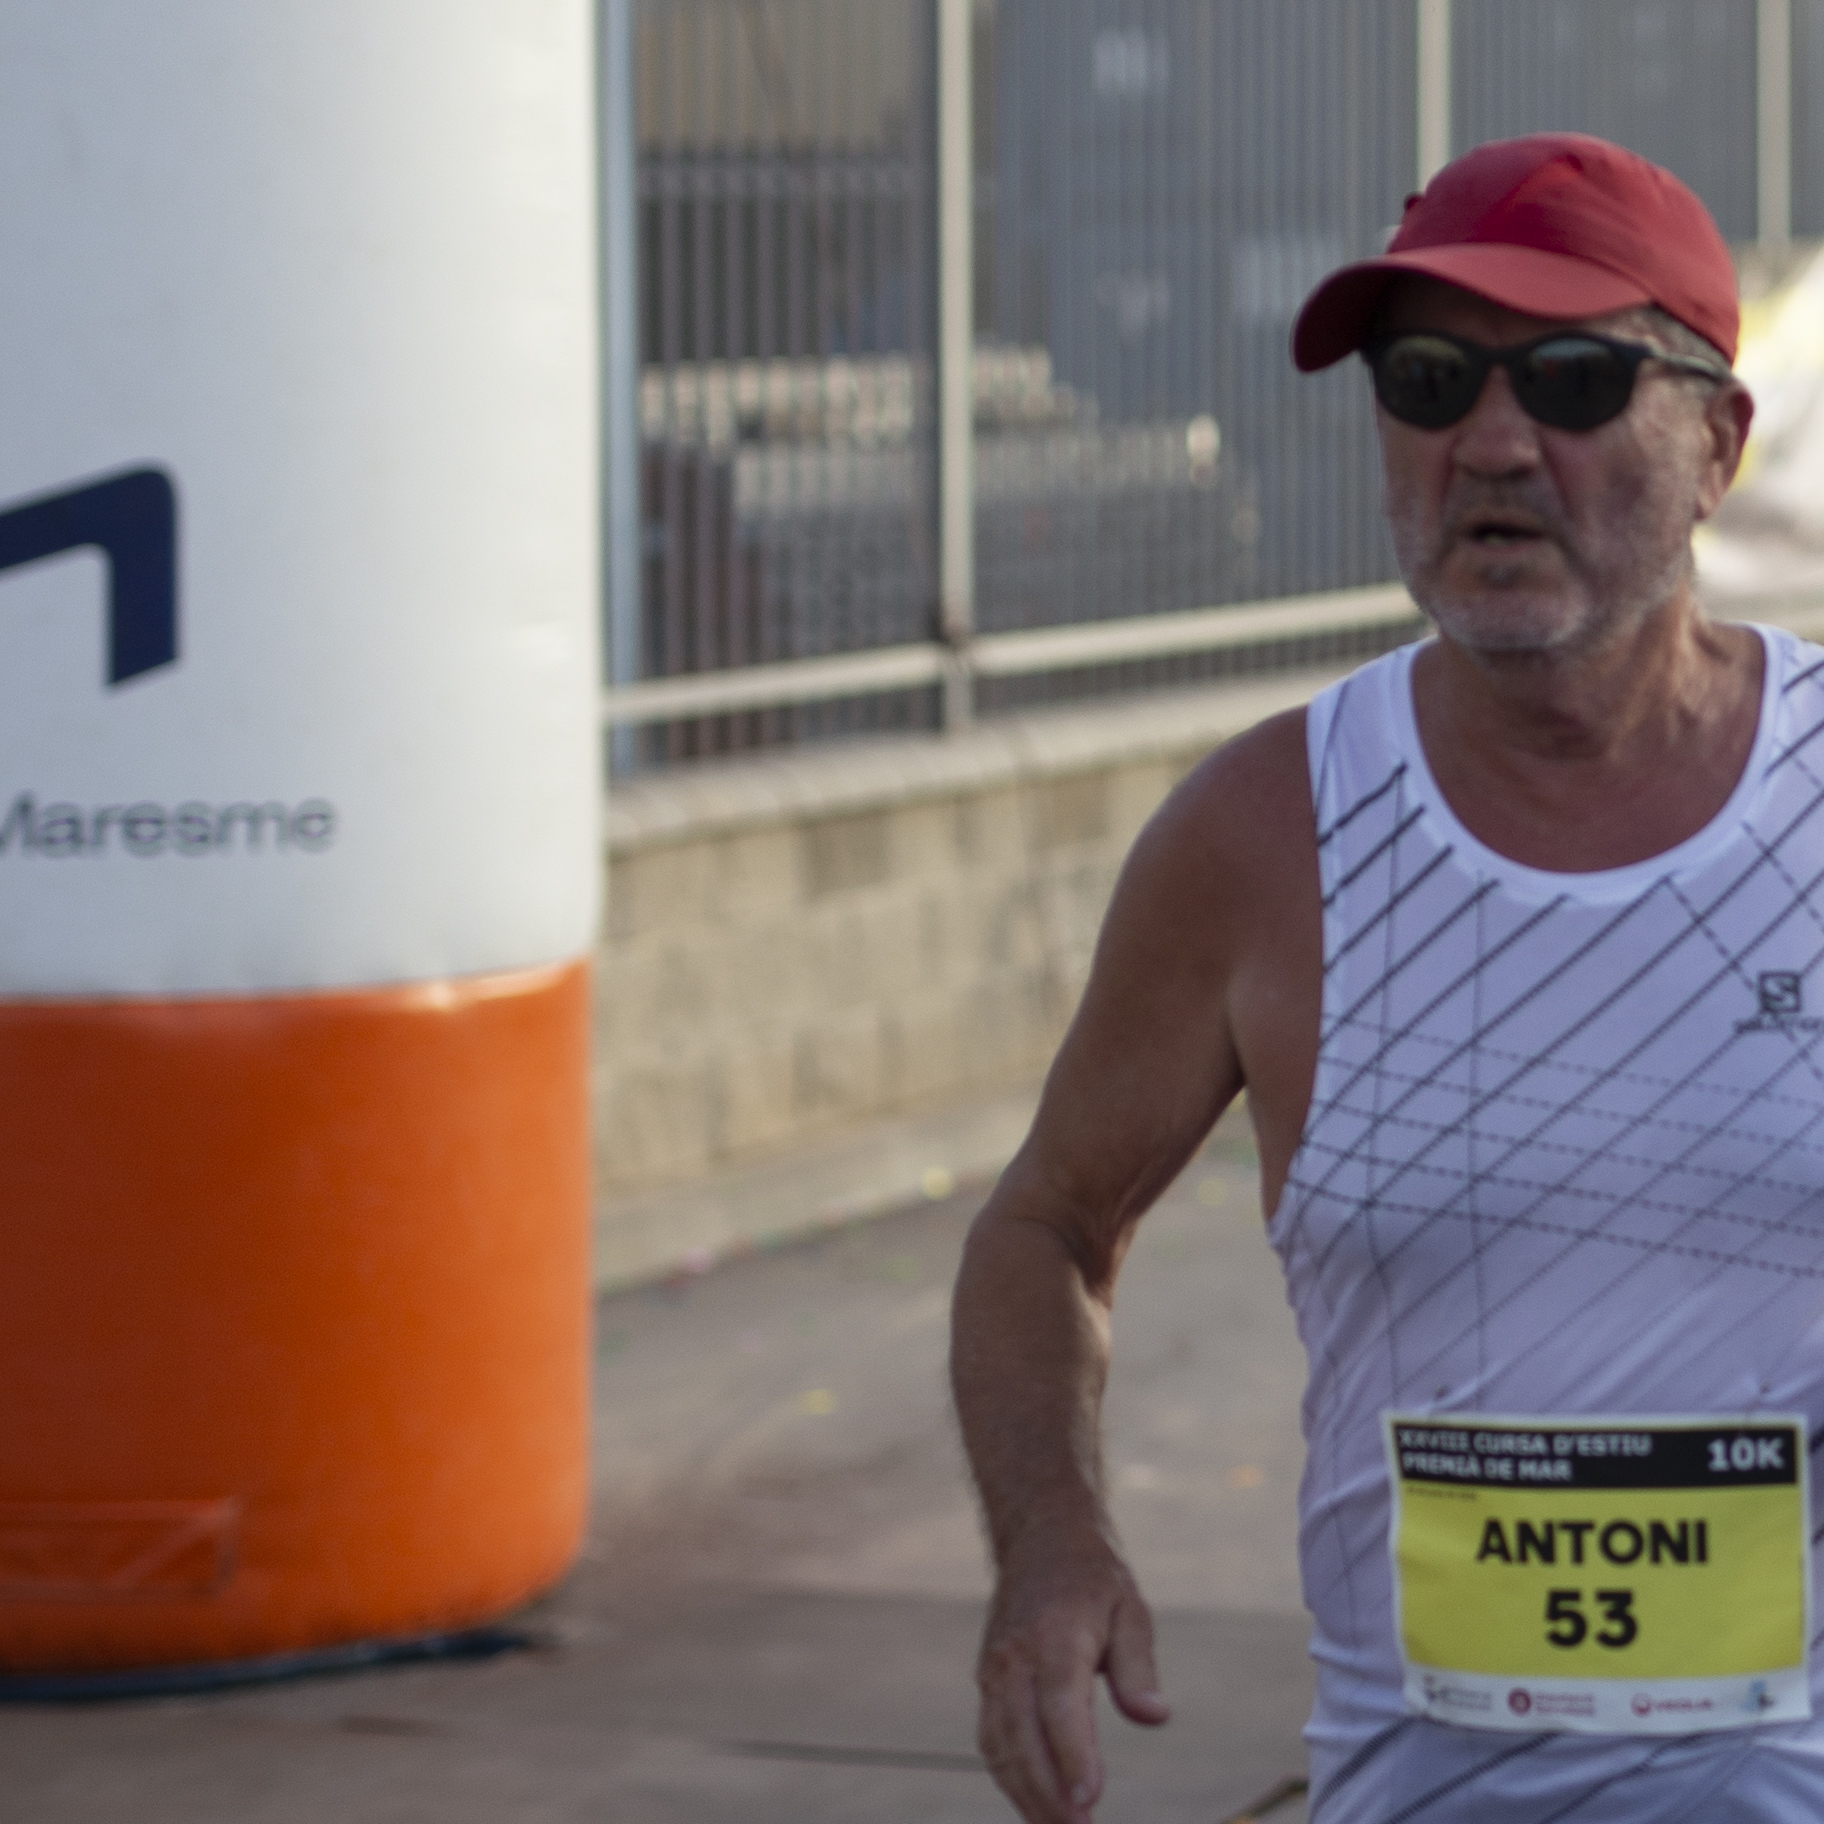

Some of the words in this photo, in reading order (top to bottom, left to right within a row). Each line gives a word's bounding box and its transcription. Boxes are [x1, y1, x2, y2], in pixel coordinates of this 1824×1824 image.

[1473, 1432, 1550, 1456] CURSA
[1707, 1437, 1785, 1471] 10K
[1483, 1456, 1515, 1480] DE
[1517, 1458, 1573, 1482] MAR
[1475, 1518, 1710, 1565] ANTONI
[1545, 1589, 1638, 1648] 53
